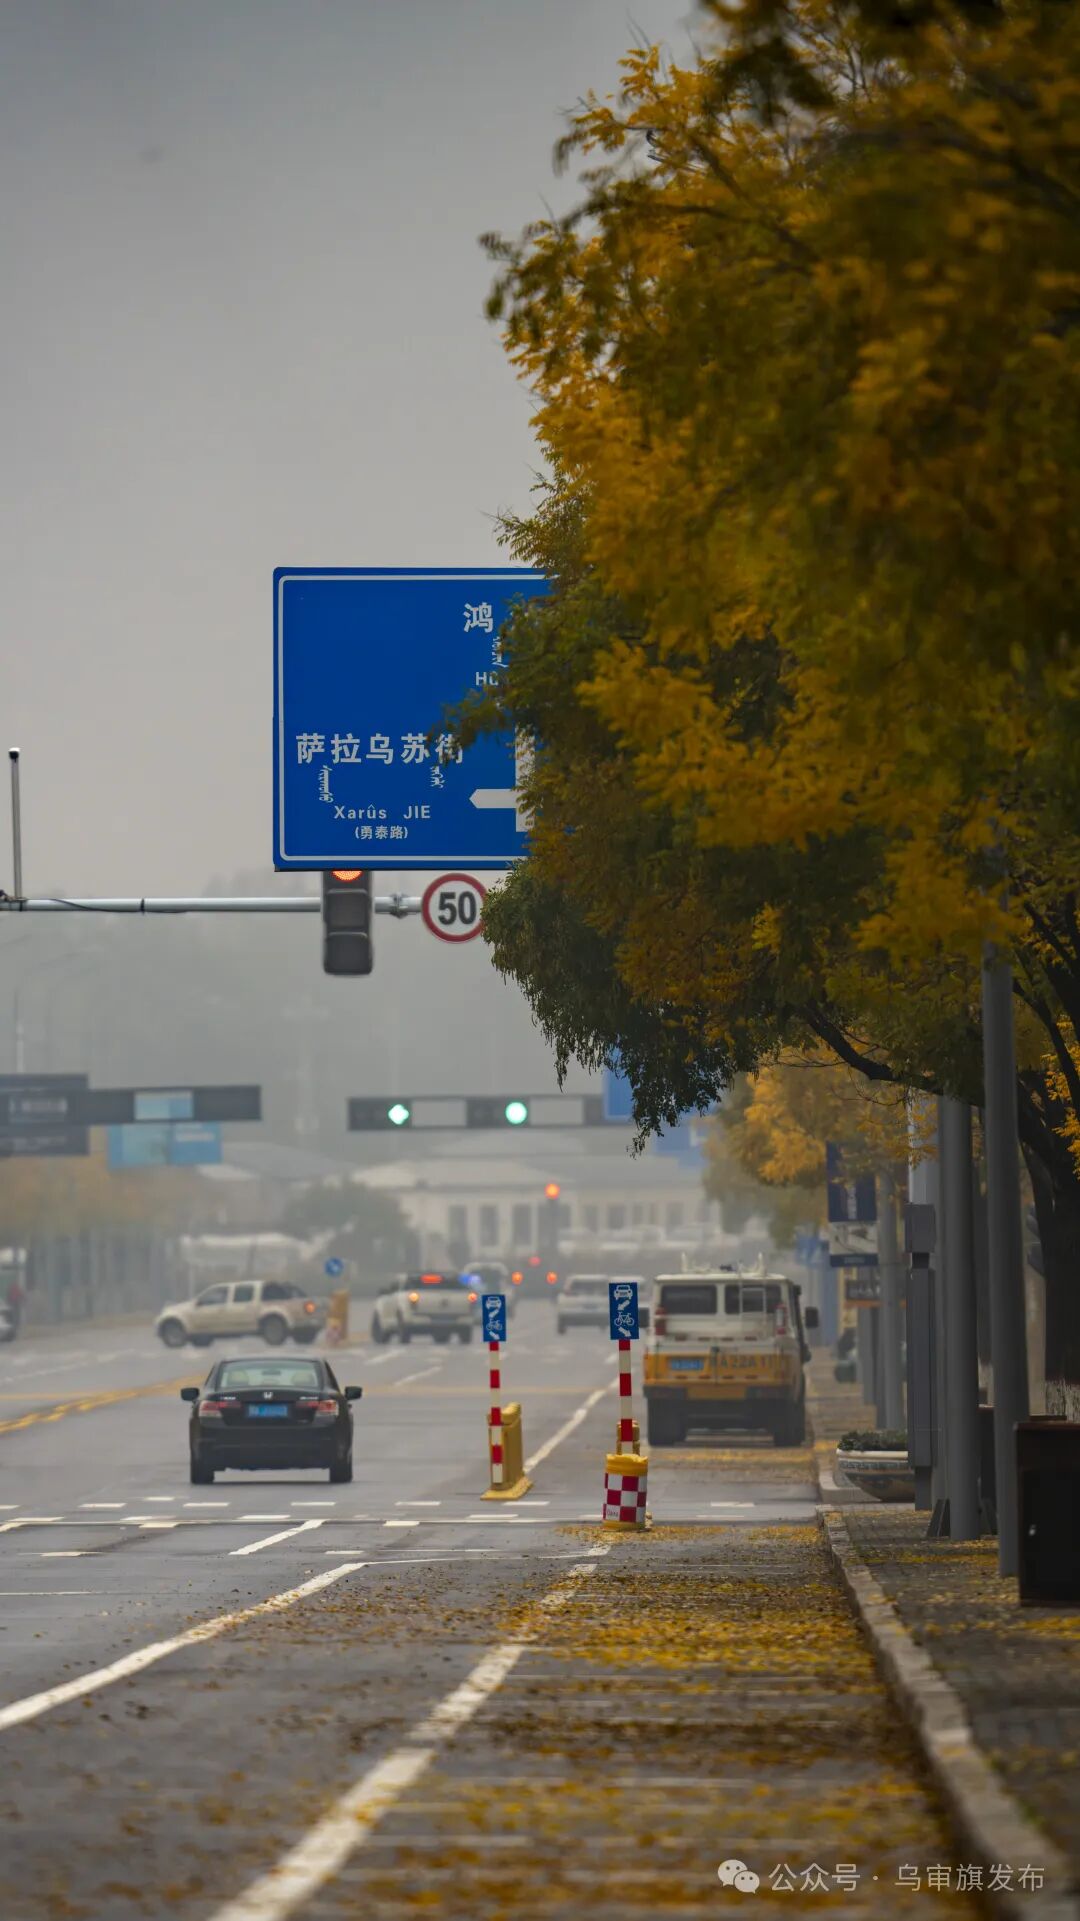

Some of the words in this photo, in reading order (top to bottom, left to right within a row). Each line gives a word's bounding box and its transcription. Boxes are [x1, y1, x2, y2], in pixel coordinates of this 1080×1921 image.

[463, 602, 494, 633] 鸿
[296, 733, 463, 765] 萨拉乌苏街
[333, 803, 388, 820] Xarûs
[403, 804, 432, 820] JIE
[438, 890, 477, 926] 50
